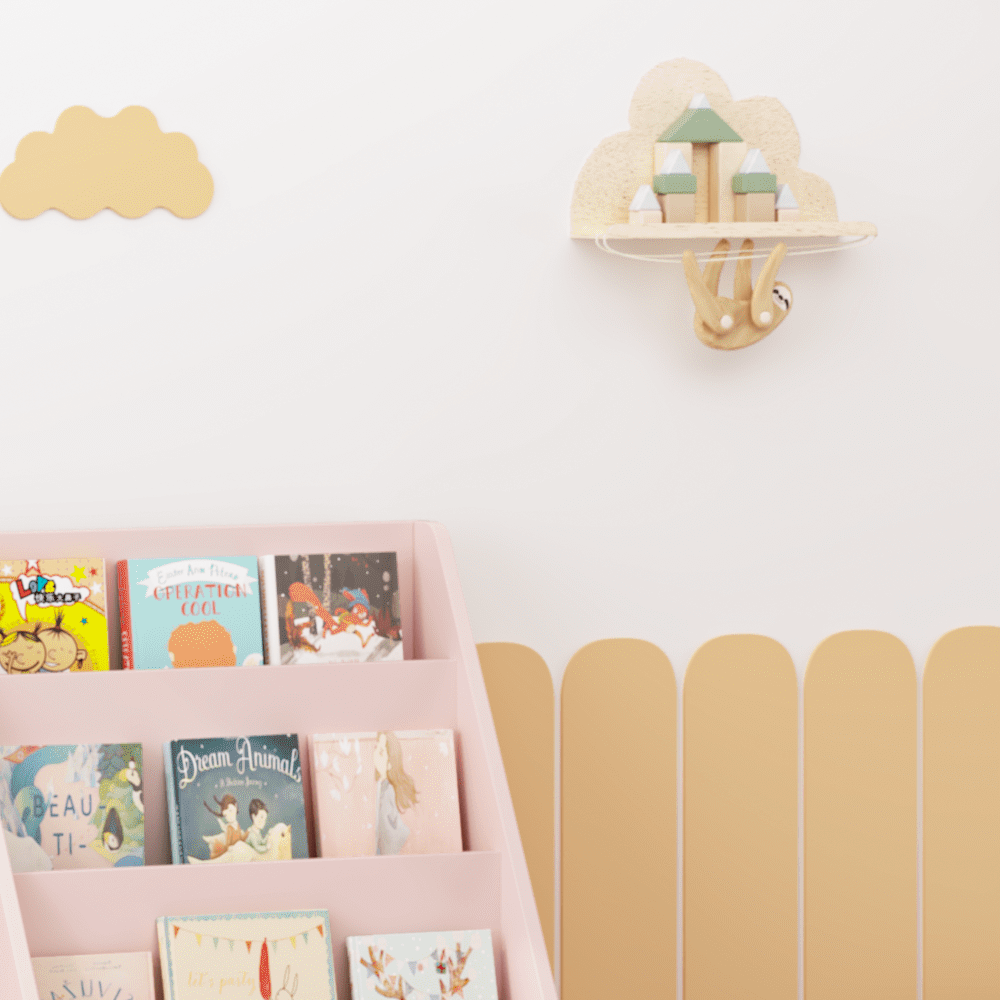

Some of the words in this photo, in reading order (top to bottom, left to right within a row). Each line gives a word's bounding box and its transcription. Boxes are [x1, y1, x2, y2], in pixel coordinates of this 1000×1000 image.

[153, 583, 247, 601] OPERATION
[181, 600, 221, 616] COOL
[177, 745, 233, 789] Dream
[236, 735, 302, 783] Animals
